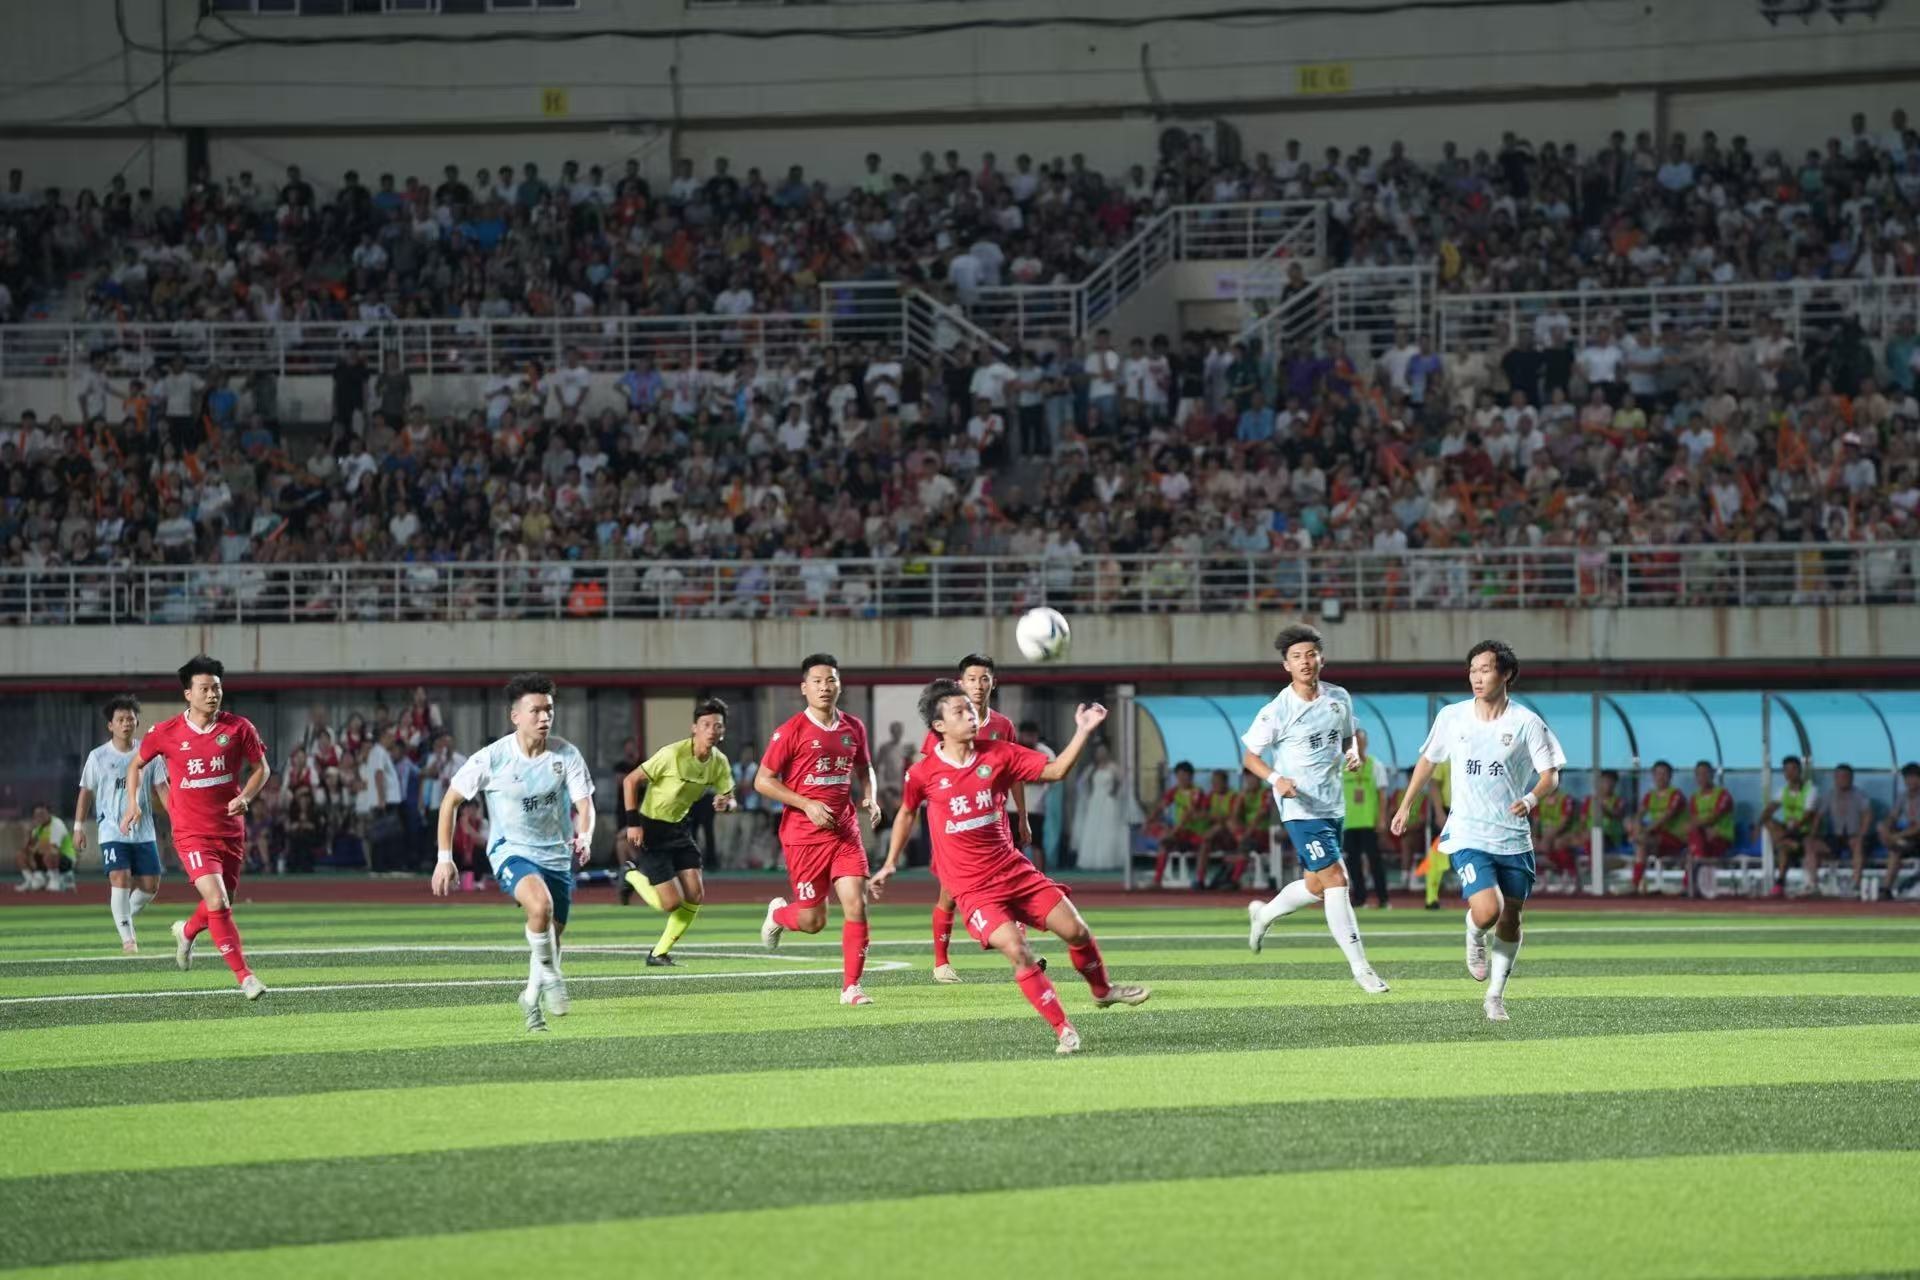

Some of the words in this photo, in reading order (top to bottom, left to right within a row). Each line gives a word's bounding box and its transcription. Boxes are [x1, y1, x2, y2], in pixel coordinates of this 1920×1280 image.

[1309, 729, 1340, 750] 新余
[187, 755, 225, 775] 抚州
[816, 756, 848, 773] 抚州
[1466, 759, 1504, 776] 新余
[522, 791, 557, 812] 新余
[949, 788, 992, 816] 抚州
[103, 848, 117, 865] 24
[188, 851, 203, 870] 11
[1305, 840, 1326, 861] 36
[1457, 862, 1477, 888] 50
[797, 881, 816, 901] 28
[969, 908, 988, 933] 12
